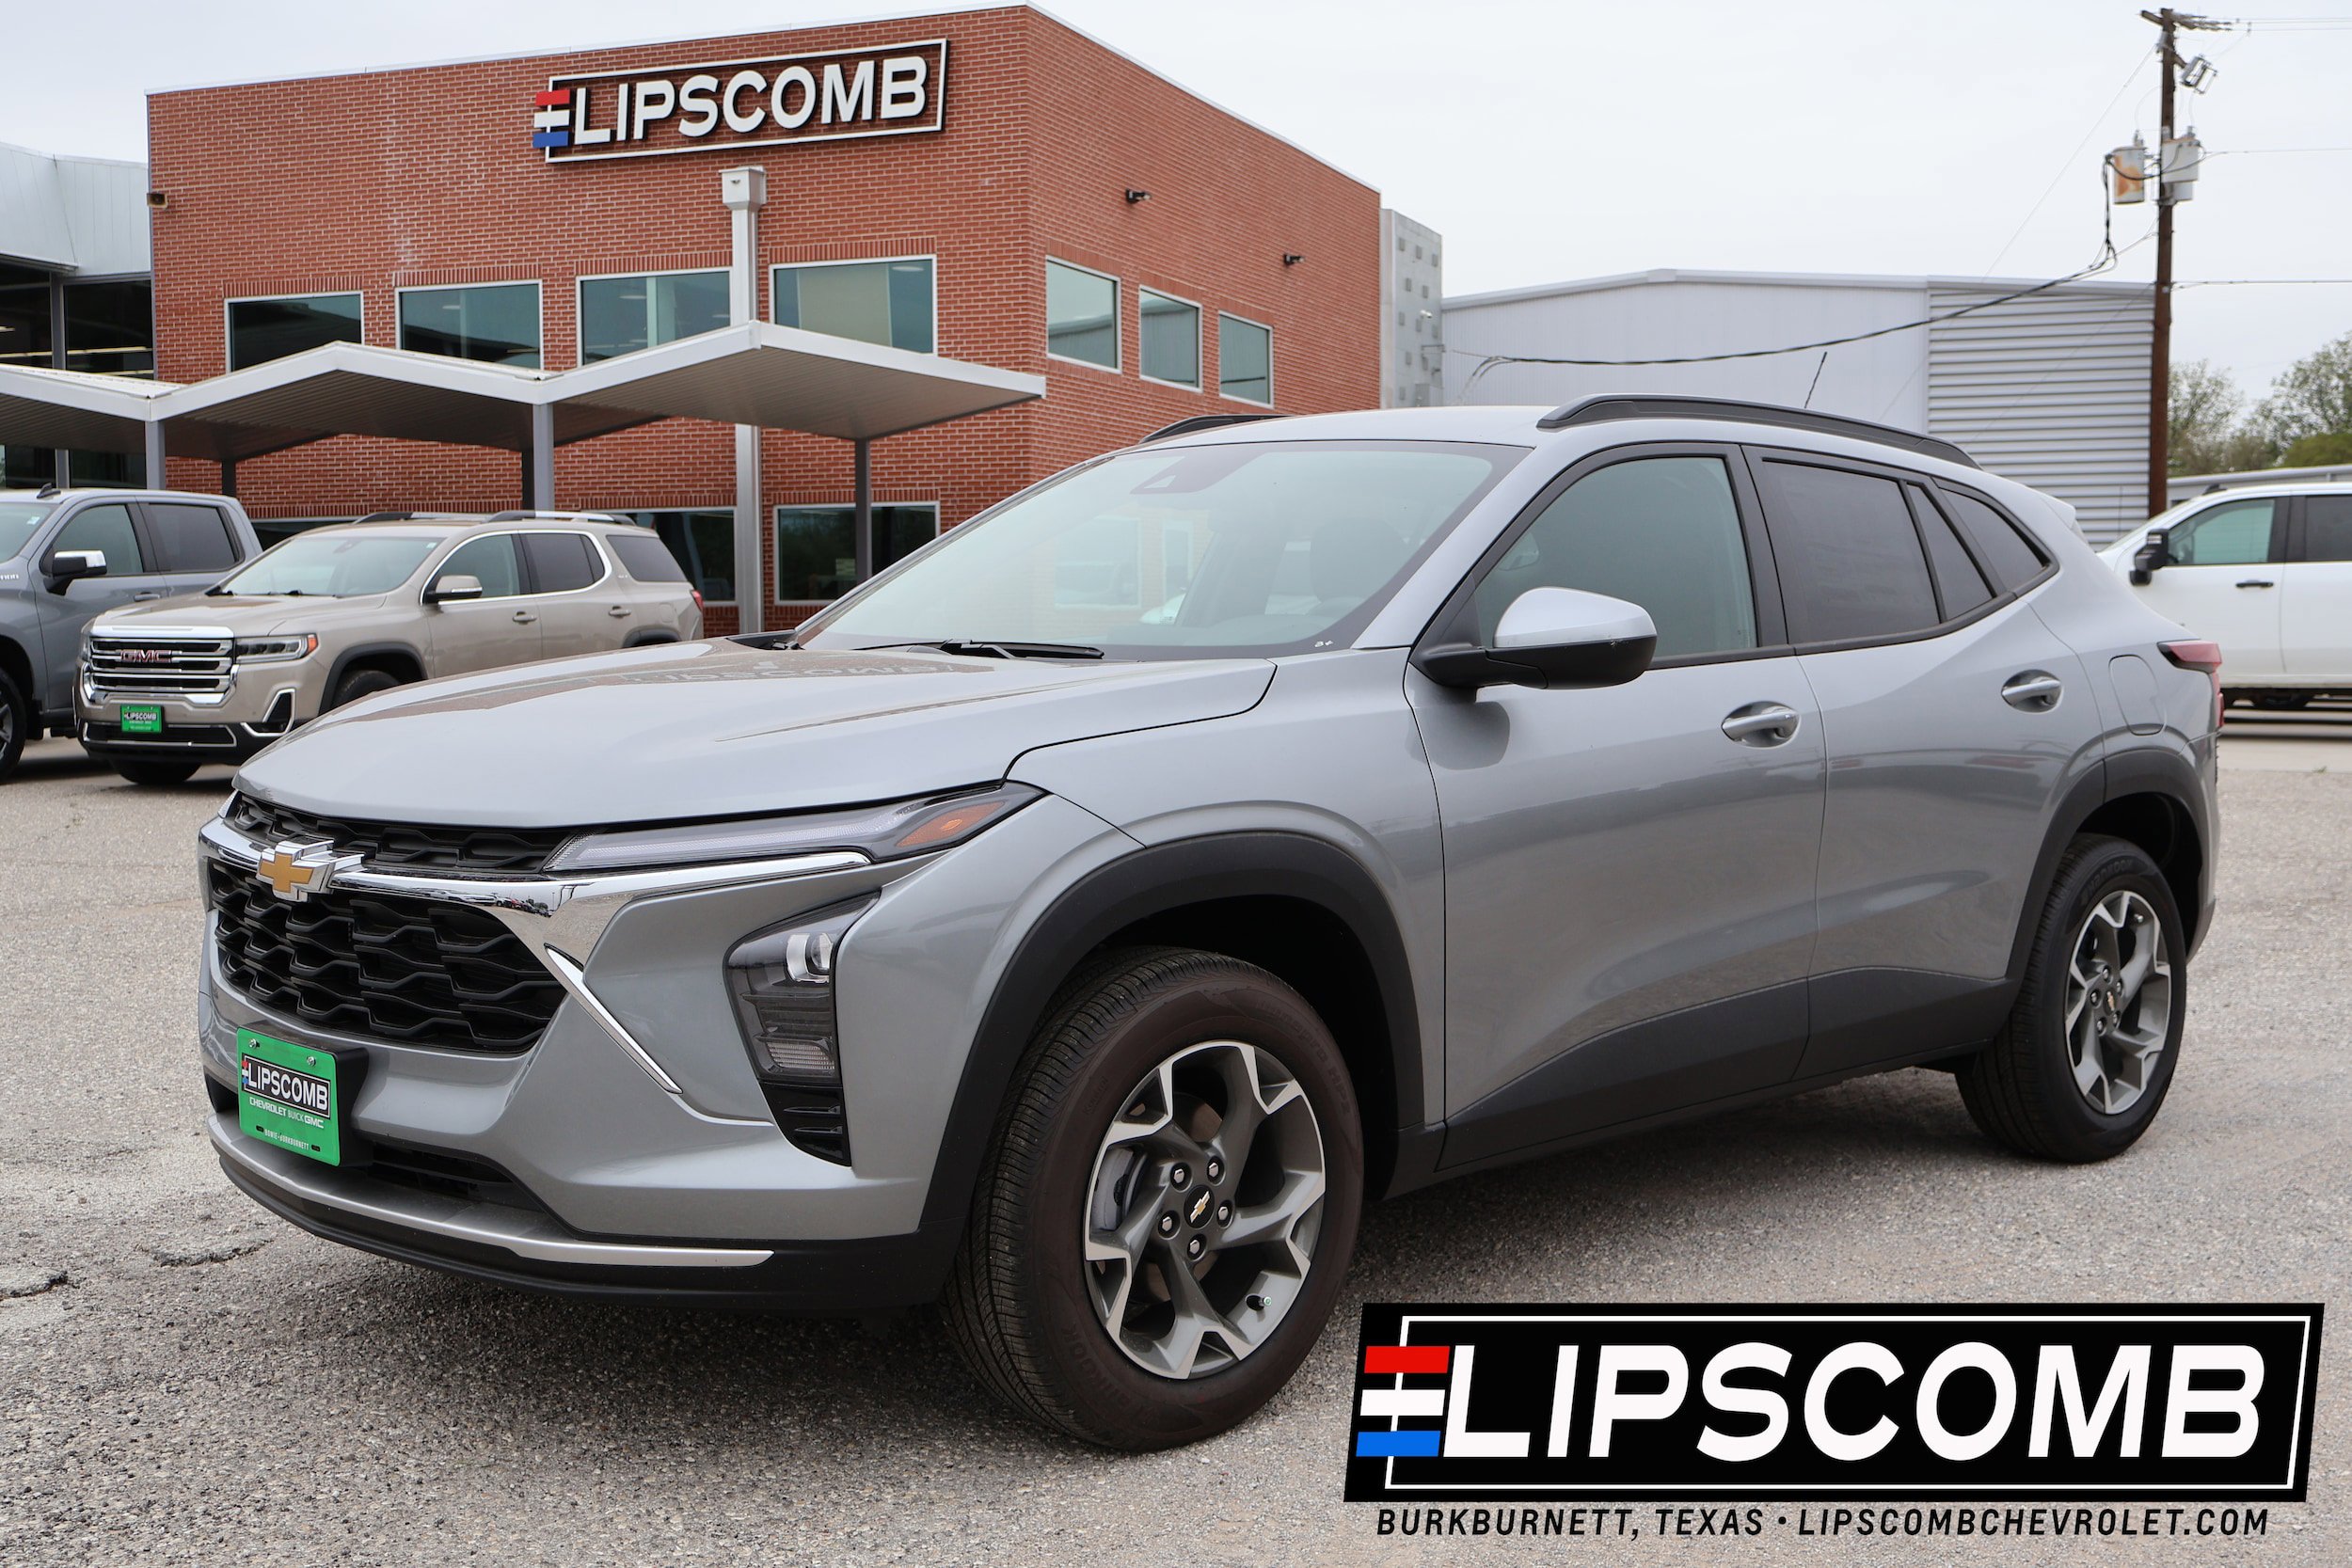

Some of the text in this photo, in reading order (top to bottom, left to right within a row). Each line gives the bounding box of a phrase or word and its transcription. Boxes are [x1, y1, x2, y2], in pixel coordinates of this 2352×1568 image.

[574, 56, 927, 145] LIPSCOMB
[120, 649, 171, 663] GMC
[248, 1063, 327, 1110] LIPSCOMB
[249, 1097, 324, 1129] CHEVROLET BUICK GMC
